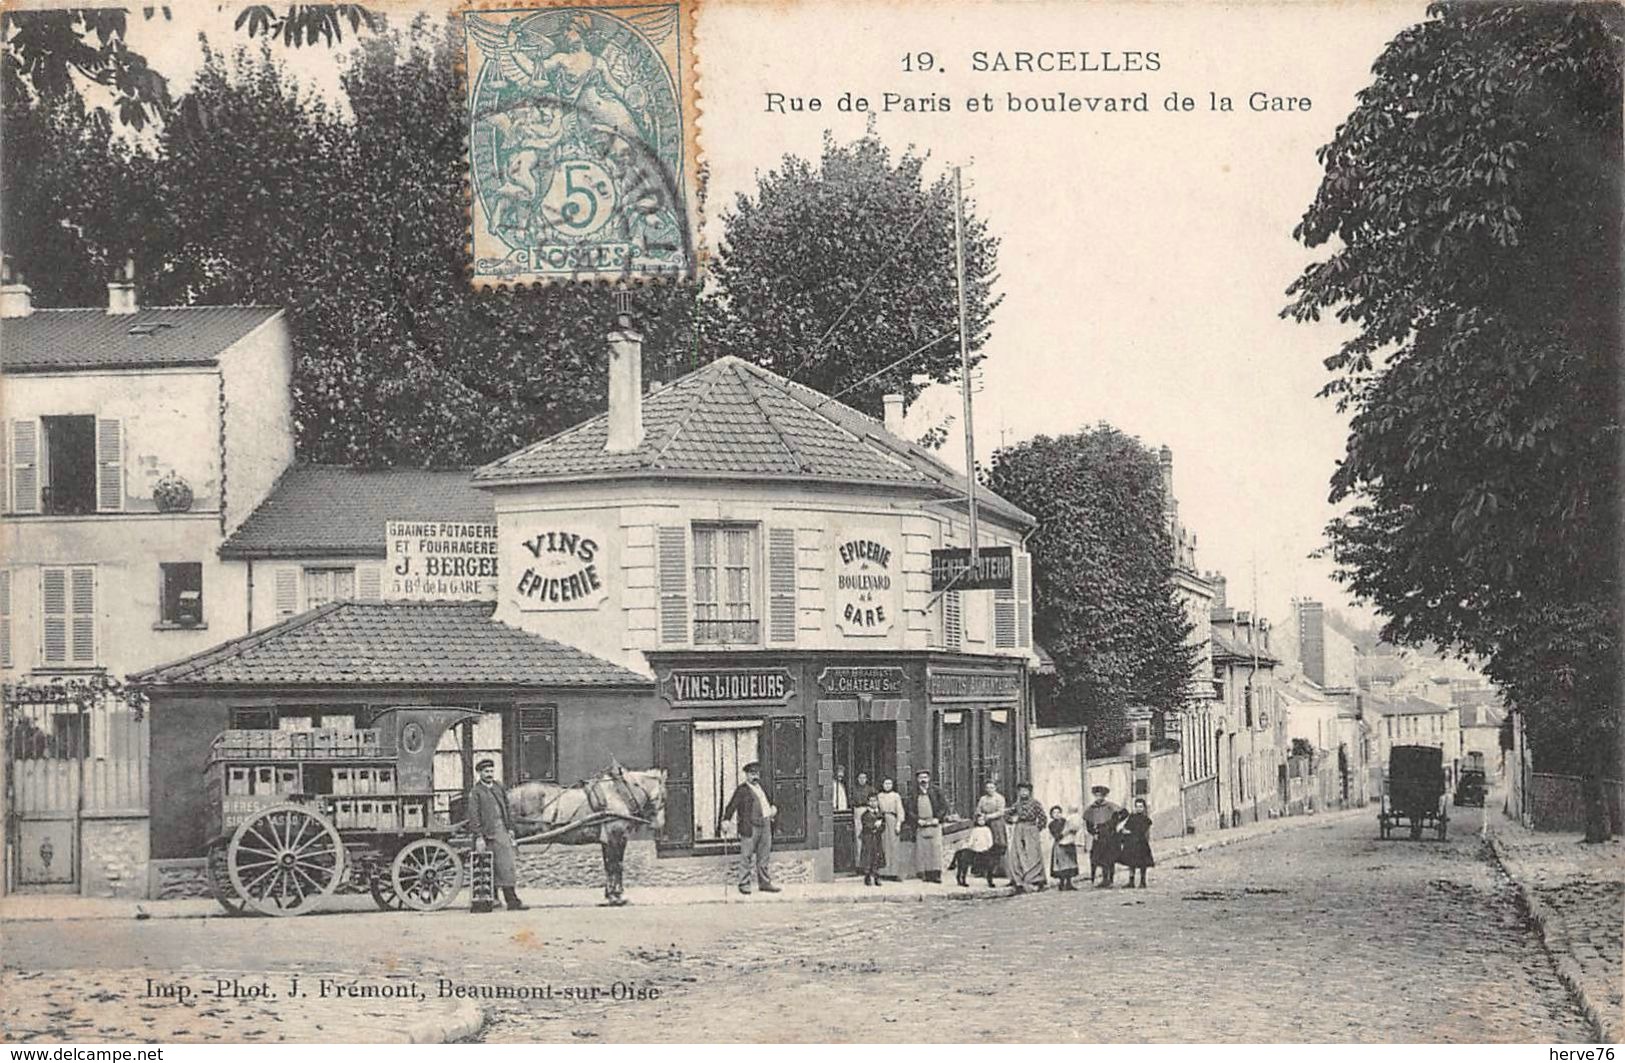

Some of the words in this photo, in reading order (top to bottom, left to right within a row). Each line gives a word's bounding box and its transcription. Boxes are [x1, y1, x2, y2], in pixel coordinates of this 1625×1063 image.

[390, 524, 437, 537] GRAINES
[395, 540, 411, 553] ET
[522, 532, 599, 563] VINS
[395, 557, 420, 576] J.
[423, 579, 436, 594] de
[438, 579, 447, 594] la
[450, 580, 482, 594] GARE
[838, 575, 891, 591] BOULEVARD
[844, 603, 886, 628] GARE
[715, 675, 784, 699] LIQUEURS
